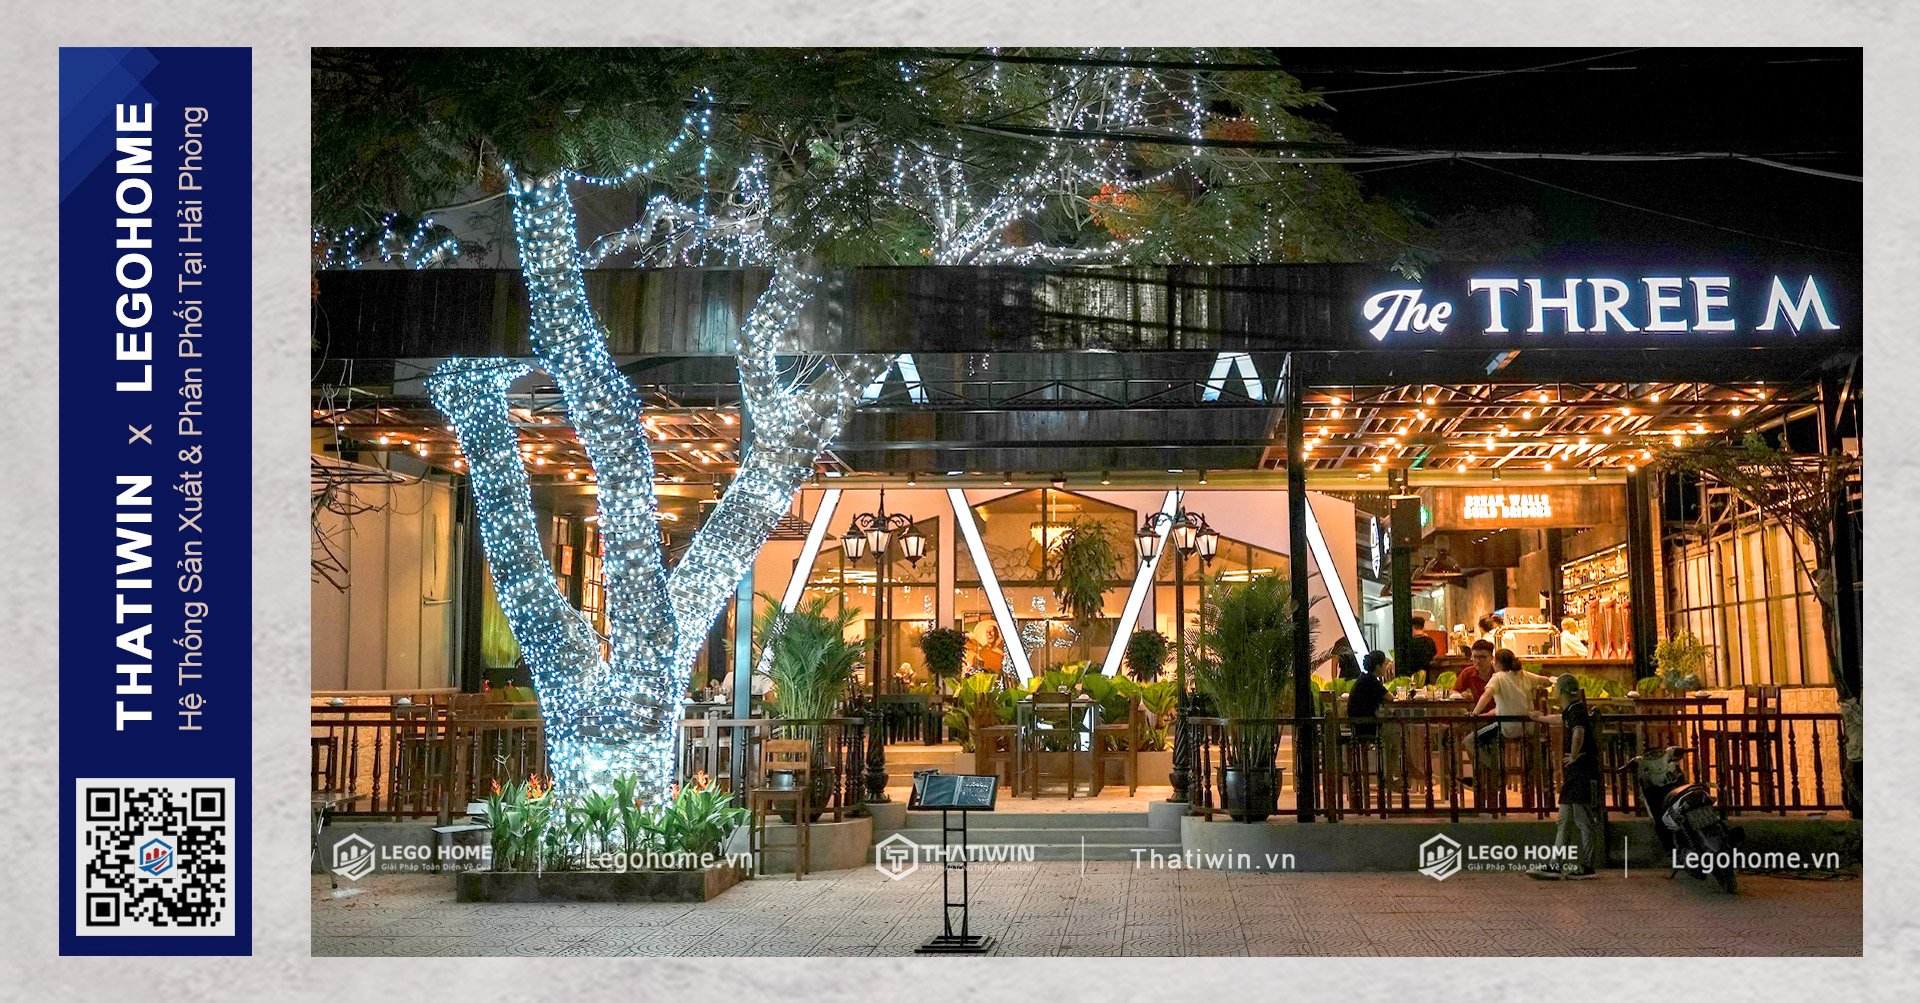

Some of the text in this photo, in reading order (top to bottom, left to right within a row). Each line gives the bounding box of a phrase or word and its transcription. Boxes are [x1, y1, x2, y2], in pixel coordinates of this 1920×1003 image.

[1362, 274, 1840, 342] The THREE M
[1509, 494, 1550, 506] WALLS
